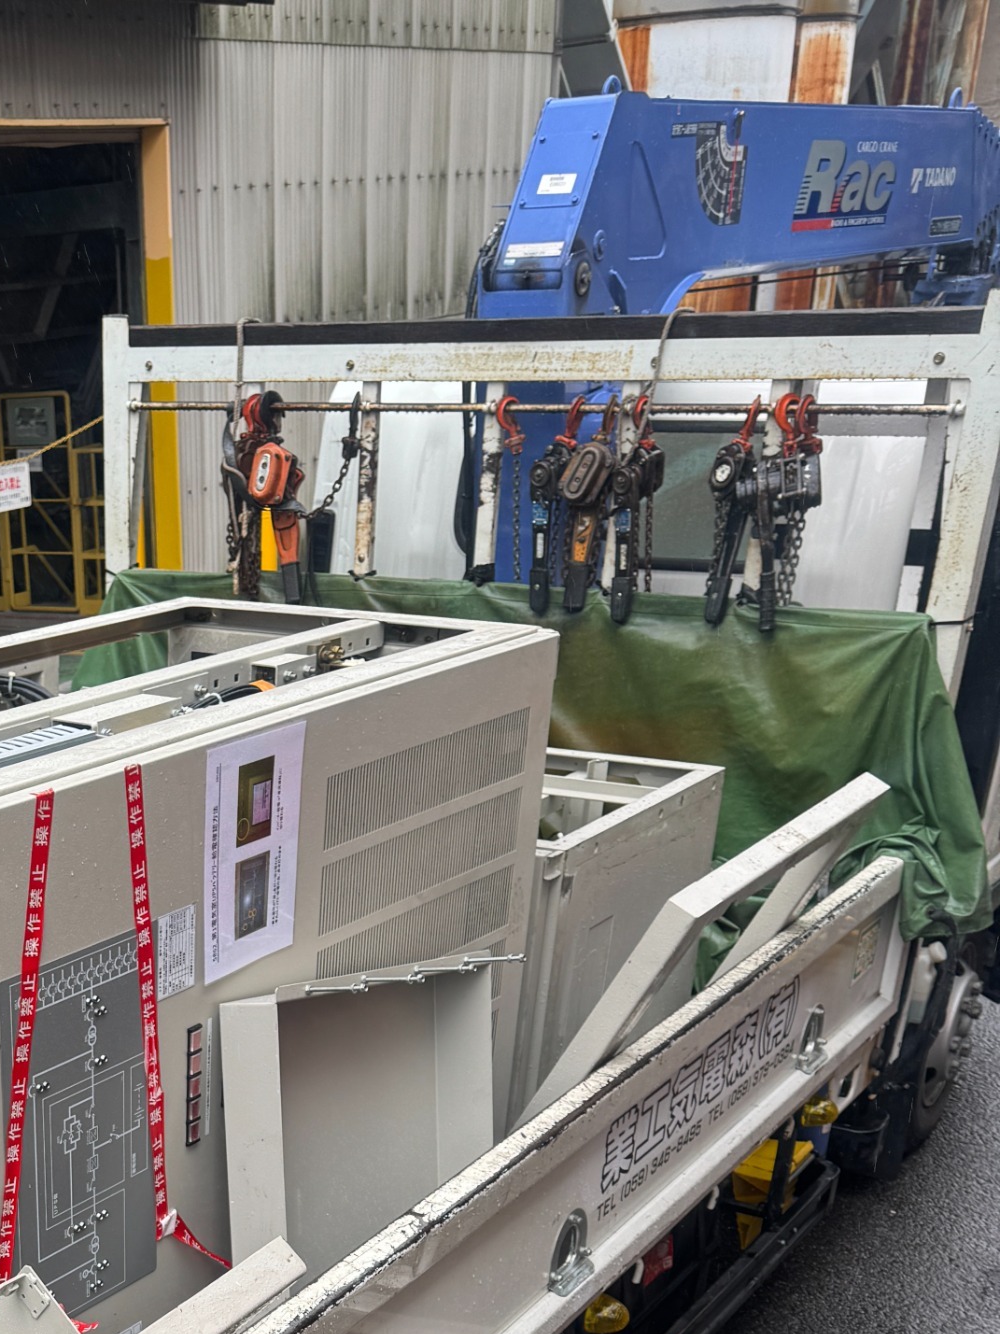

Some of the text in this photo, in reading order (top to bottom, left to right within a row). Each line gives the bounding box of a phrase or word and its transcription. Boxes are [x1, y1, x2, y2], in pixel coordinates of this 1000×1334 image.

[793, 140, 896, 215] Rac
[857, 141, 898, 153] CARGO CRANE
[925, 167, 957, 187] TADANO
[25, 863, 46, 957] 操作禁止
[134, 861, 152, 948] 操作禁止
[16, 973, 37, 1063] 操作禁止
[140, 958, 157, 1039] 操作禁止
[7, 1077, 27, 1163] 操作禁止
[597, 1196, 616, 1222] TEL
[620, 1165, 649, 1203] (059)
[708, 1102, 724, 1126] TEL
[728, 1079, 750, 1110] (059)
[152, 1134, 166, 1207] 操作禁止
